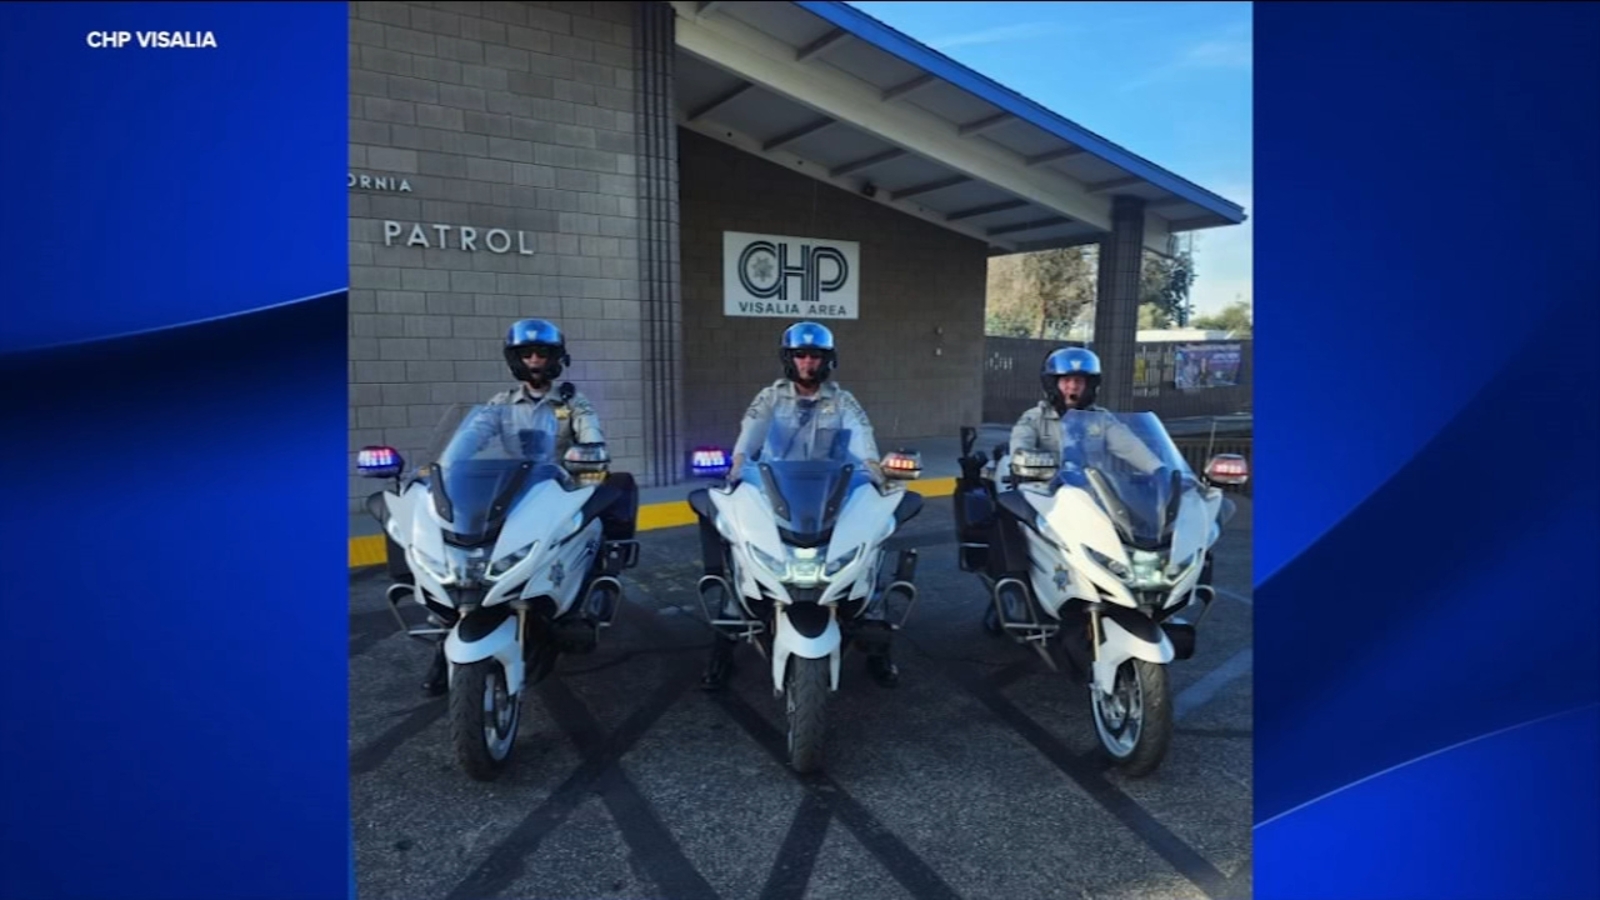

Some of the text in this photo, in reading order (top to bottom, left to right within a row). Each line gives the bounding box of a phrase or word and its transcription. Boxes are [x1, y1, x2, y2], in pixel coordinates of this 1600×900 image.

[384, 220, 534, 255] PATROL
[738, 241, 849, 302] CHP
[739, 301, 847, 316] VISALIA AREA
